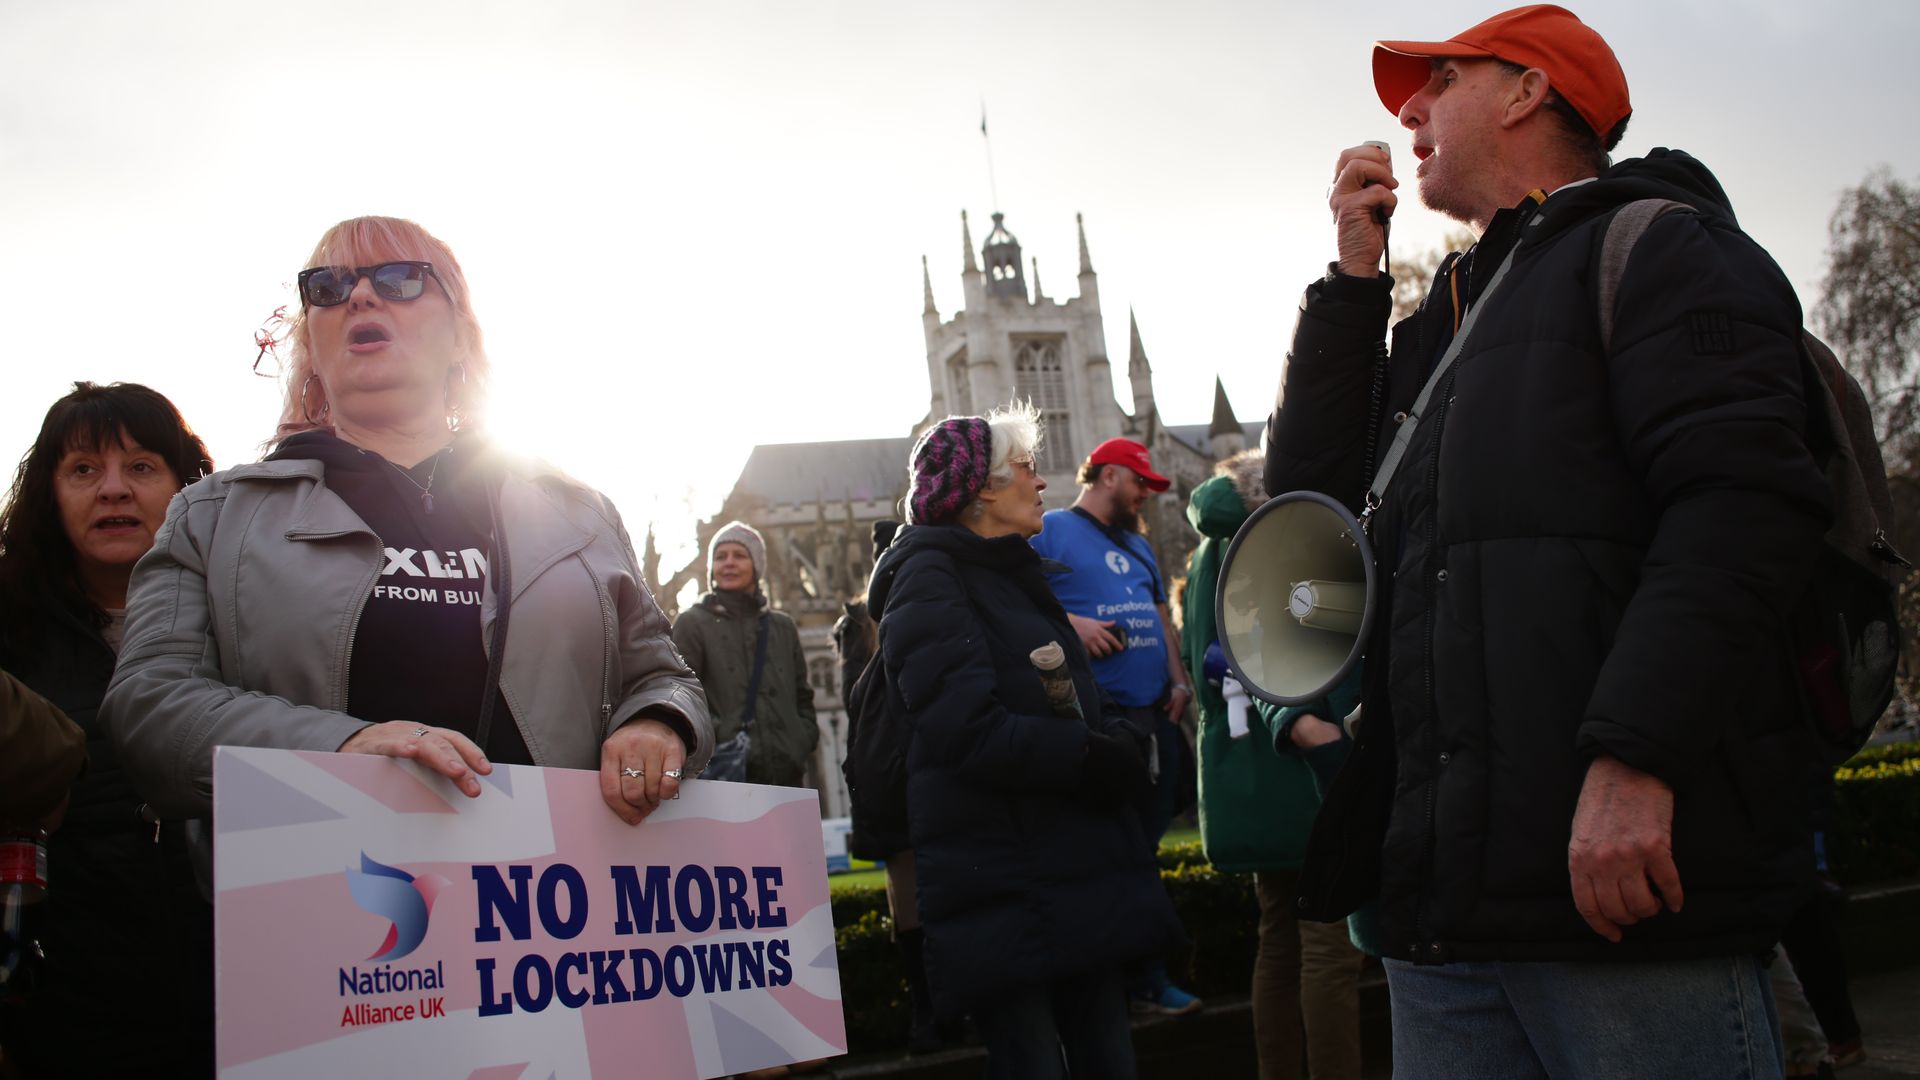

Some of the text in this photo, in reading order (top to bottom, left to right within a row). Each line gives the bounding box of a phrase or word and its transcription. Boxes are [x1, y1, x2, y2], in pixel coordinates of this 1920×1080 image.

[374, 585, 438, 603] FROM
[1125, 617, 1154, 629] Your
[1128, 635, 1158, 648] Mum
[472, 863, 787, 942] NO MORE
[339, 960, 444, 997] National
[475, 939, 793, 1018] LOCKDOWNS
[341, 996, 446, 1027] Alliance UK
